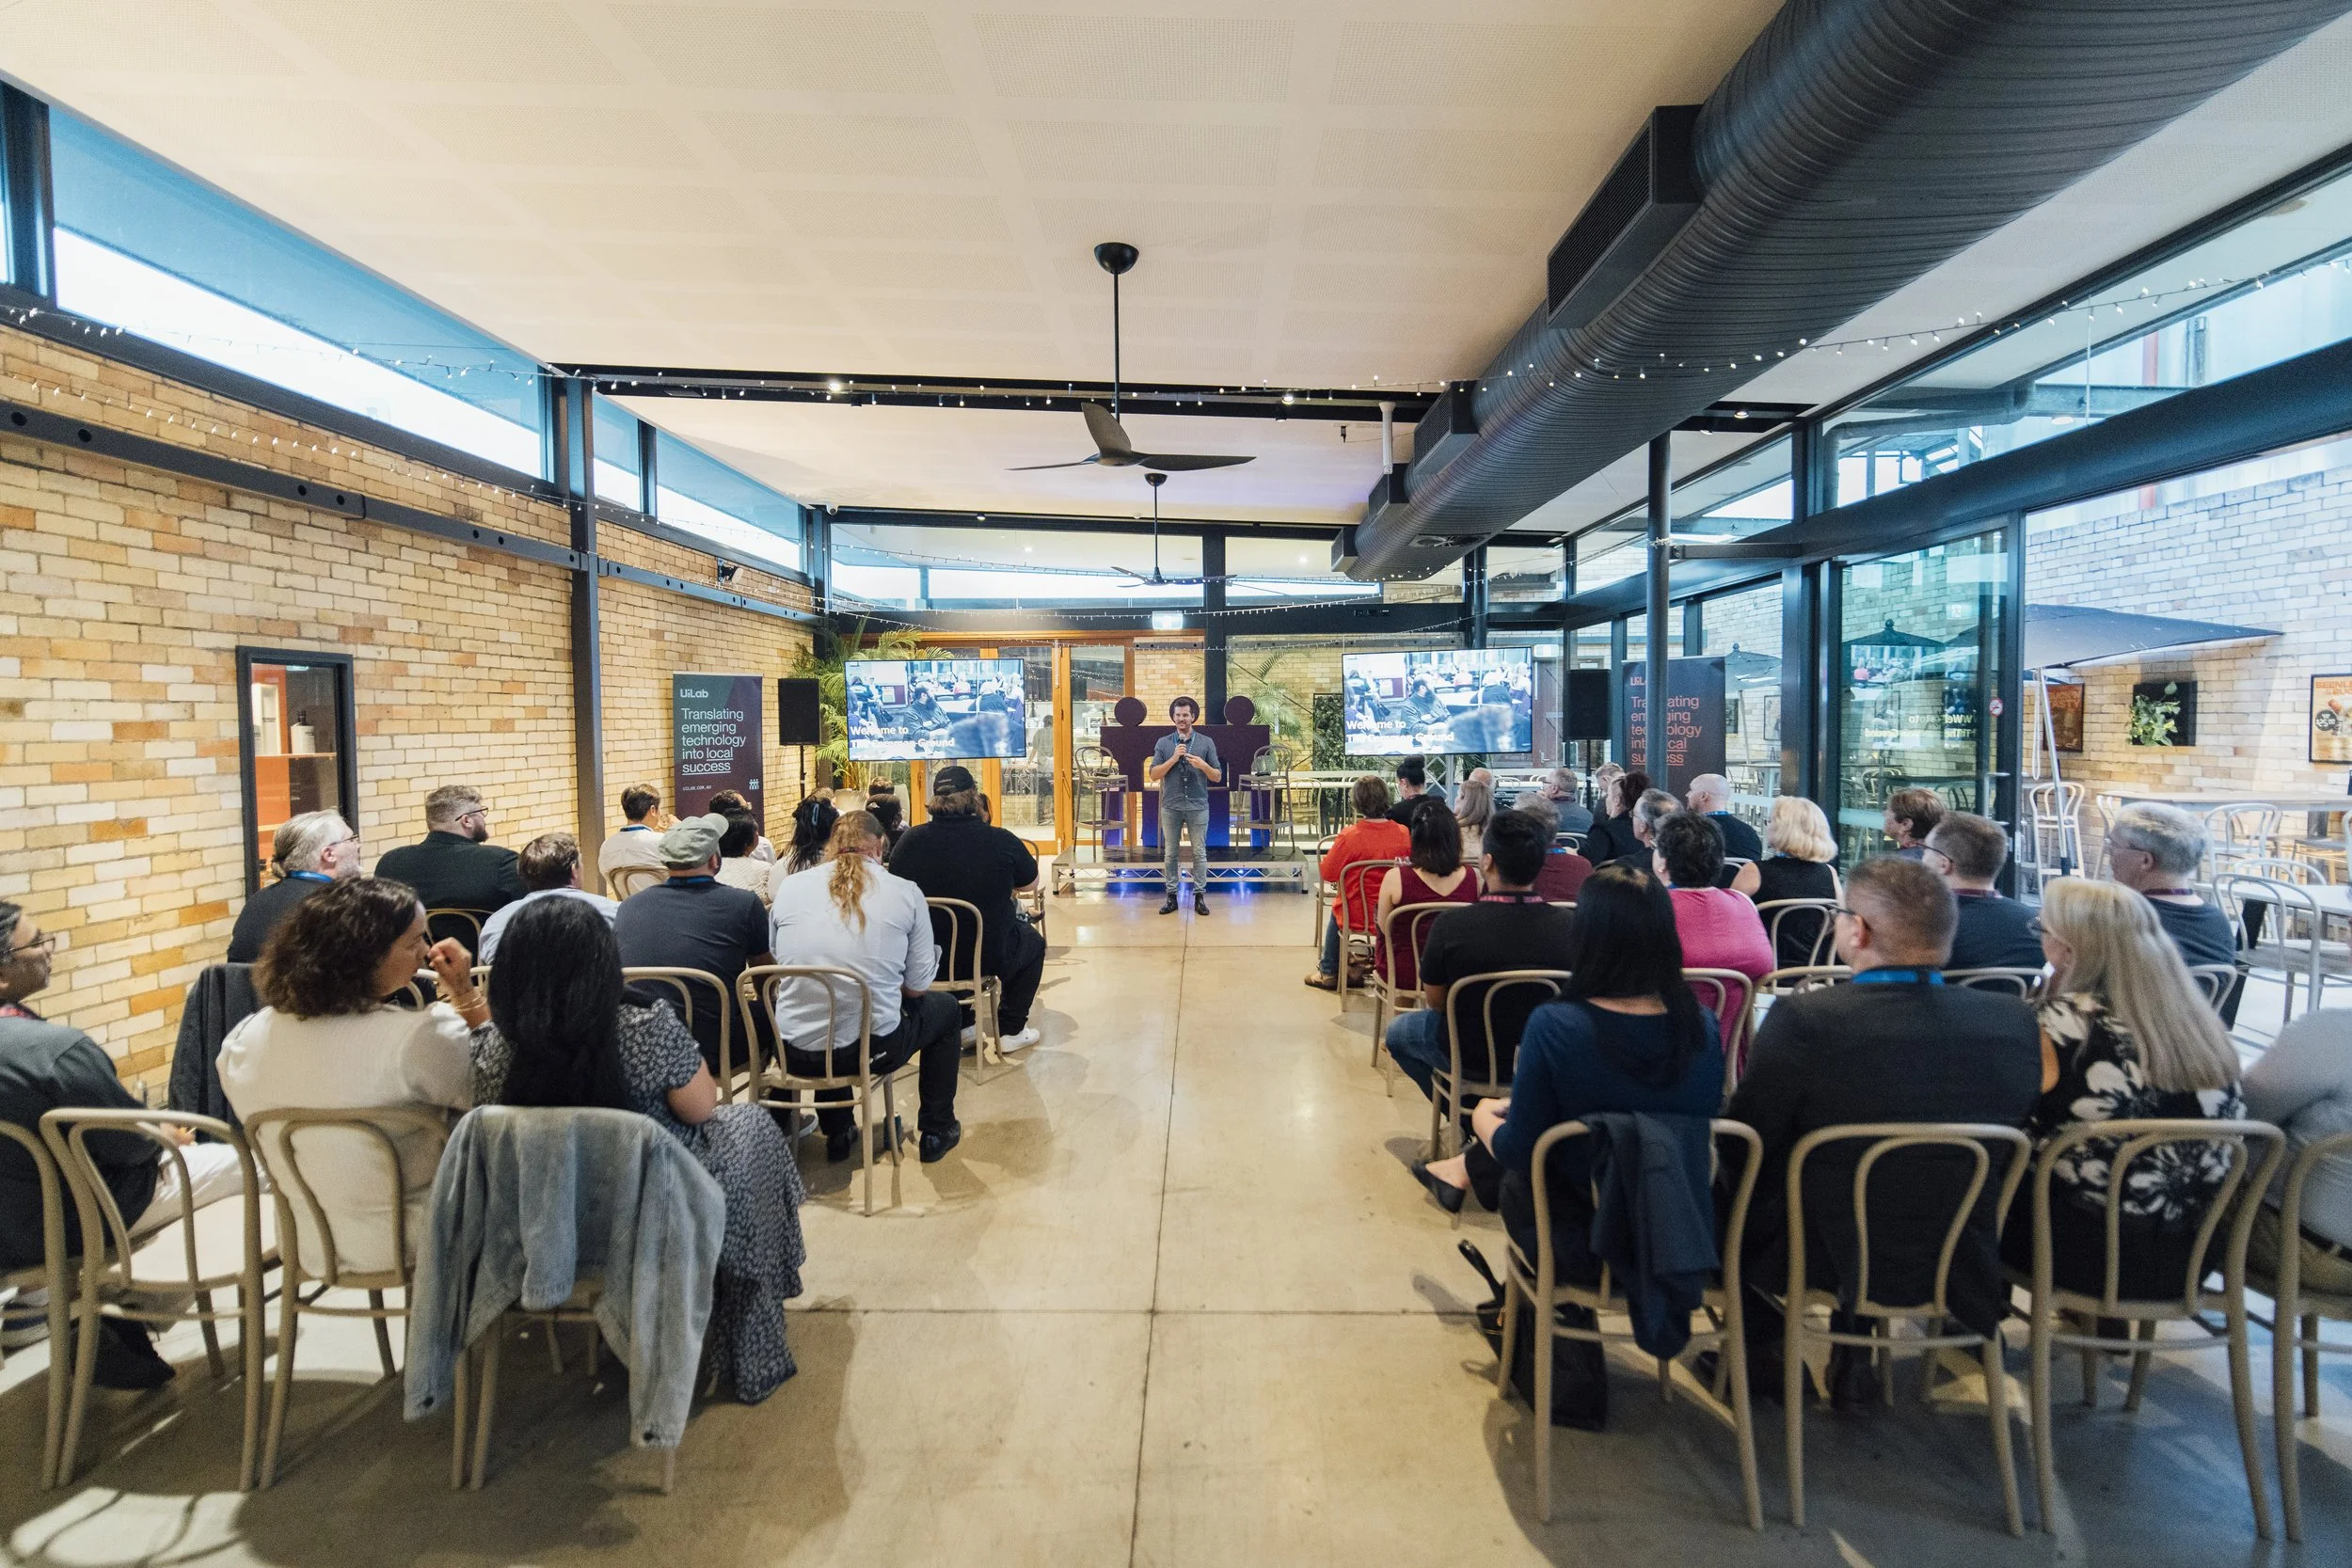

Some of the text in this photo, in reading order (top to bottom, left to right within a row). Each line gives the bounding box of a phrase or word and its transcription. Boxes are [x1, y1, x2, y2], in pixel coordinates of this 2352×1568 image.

[1630, 676, 1647, 686] UiL
[679, 689, 708, 698] UiLab
[1630, 695, 1700, 709] Traating
[680, 708, 744, 721] Translating
[1630, 710, 1691, 723] eming
[681, 721, 737, 735] emerging
[850, 726, 909, 736] Weme to
[1346, 720, 1406, 730] Weme to
[1631, 723, 1702, 737] tecology
[681, 735, 746, 748] technology
[1631, 737, 1688, 752] int cal
[682, 747, 734, 761] into local
[1631, 753, 1684, 765] suss
[682, 762, 731, 774] success
